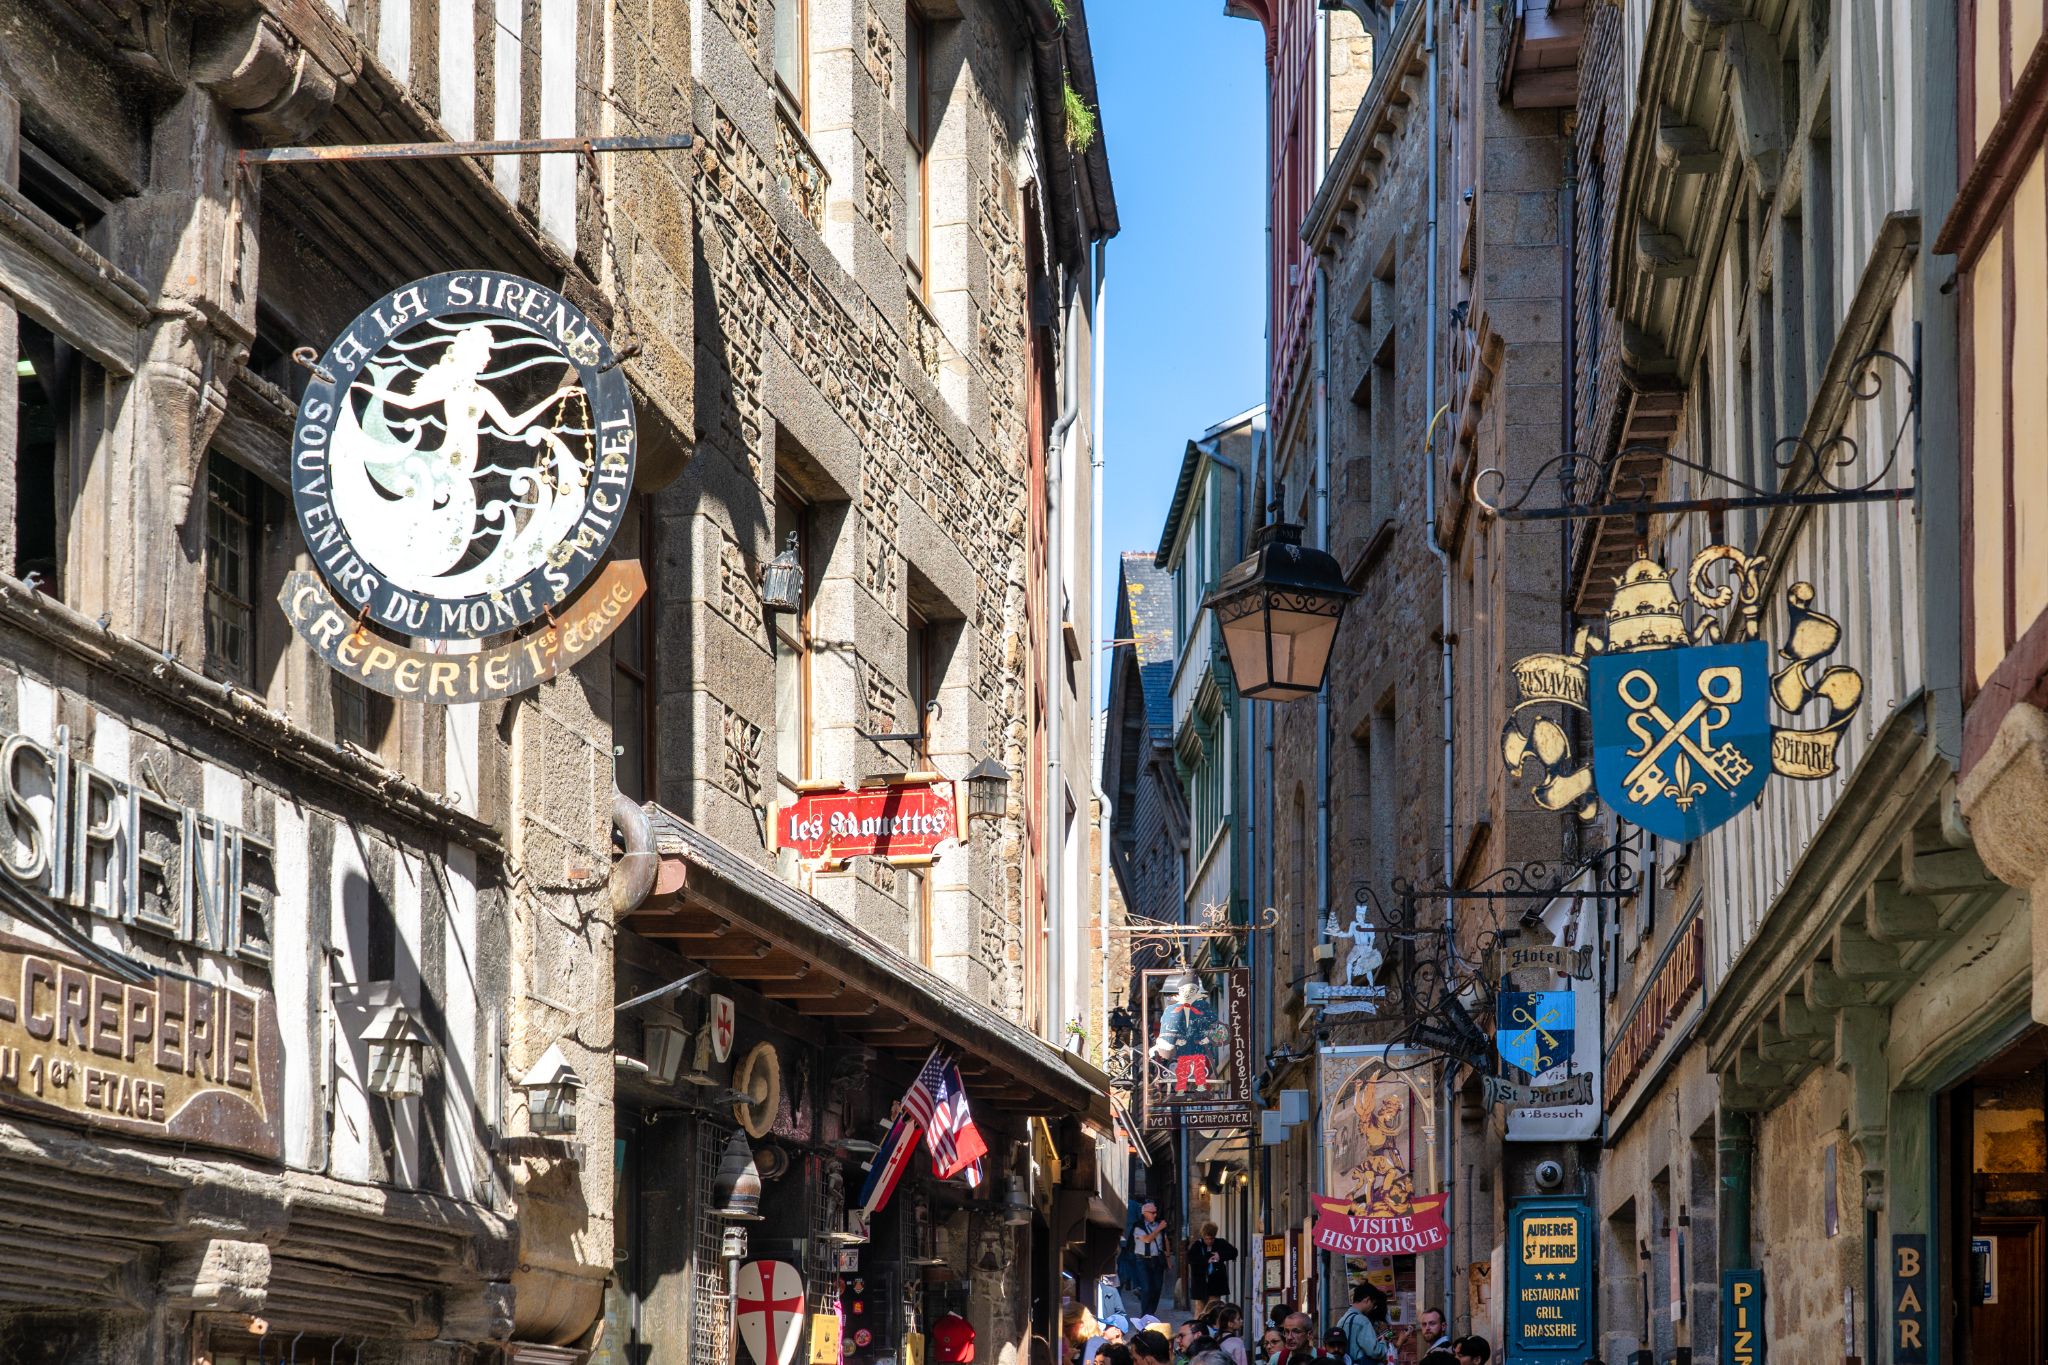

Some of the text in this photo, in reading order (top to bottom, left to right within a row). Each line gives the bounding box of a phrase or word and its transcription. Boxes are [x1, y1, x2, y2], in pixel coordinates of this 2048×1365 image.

[334, 331, 371, 372] A
[371, 287, 429, 337] LA
[297, 397, 380, 605] SOUVENIRS
[382, 591, 430, 629] DU
[440, 582, 536, 633] MONT
[790, 812, 823, 842] les
[1512, 948, 1561, 968] Hotel
[1499, 1085, 1518, 1101] St
[1533, 1108, 1583, 1119] Besuch
[1349, 1216, 1414, 1235] VISITE
[1527, 1222, 1574, 1238] AUBERGE
[1265, 1241, 1281, 1252] Bar
[1320, 1227, 1443, 1253] HISTORIQUE
[1539, 1244, 1576, 1259] PIERRE
[1522, 1287, 1580, 1302] RESTAURANT
[1897, 1247, 1921, 1349] BAR
[1536, 1306, 1563, 1319] GRILL
[1524, 1323, 1577, 1338] BRASSERIE
